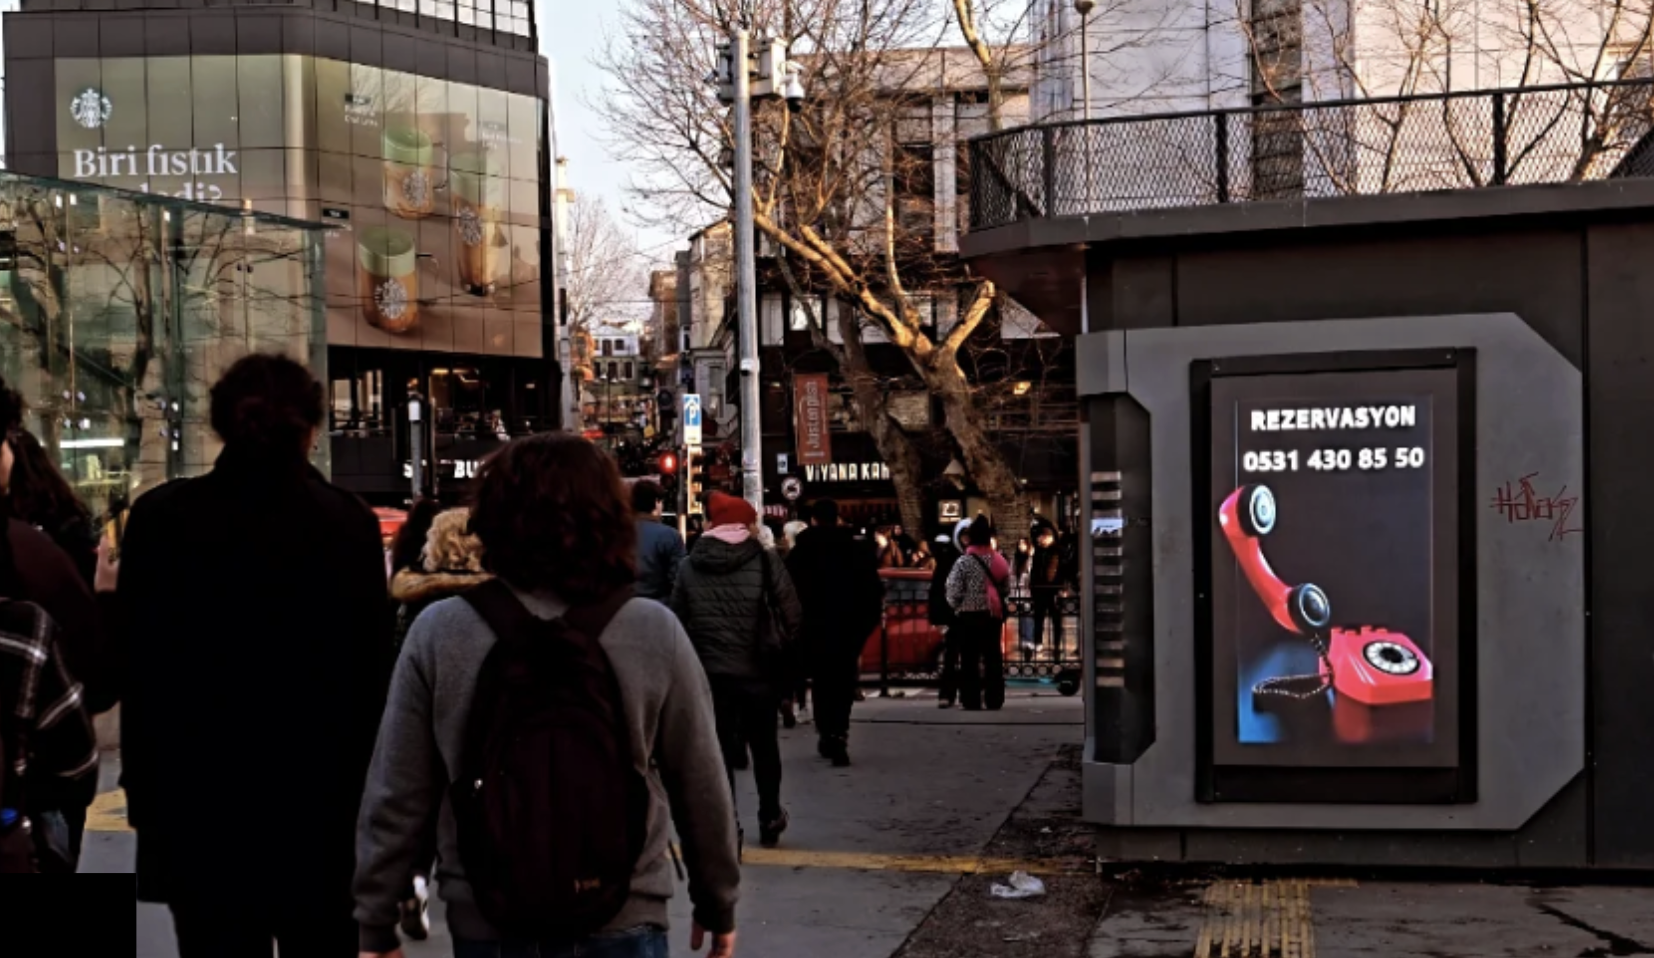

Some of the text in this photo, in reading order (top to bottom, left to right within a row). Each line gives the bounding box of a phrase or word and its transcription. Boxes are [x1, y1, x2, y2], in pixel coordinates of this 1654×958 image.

[74, 146, 138, 178] Biri
[1251, 405, 1416, 431] REZERVASYON
[1243, 447, 1424, 472] 0531 430 85 50
